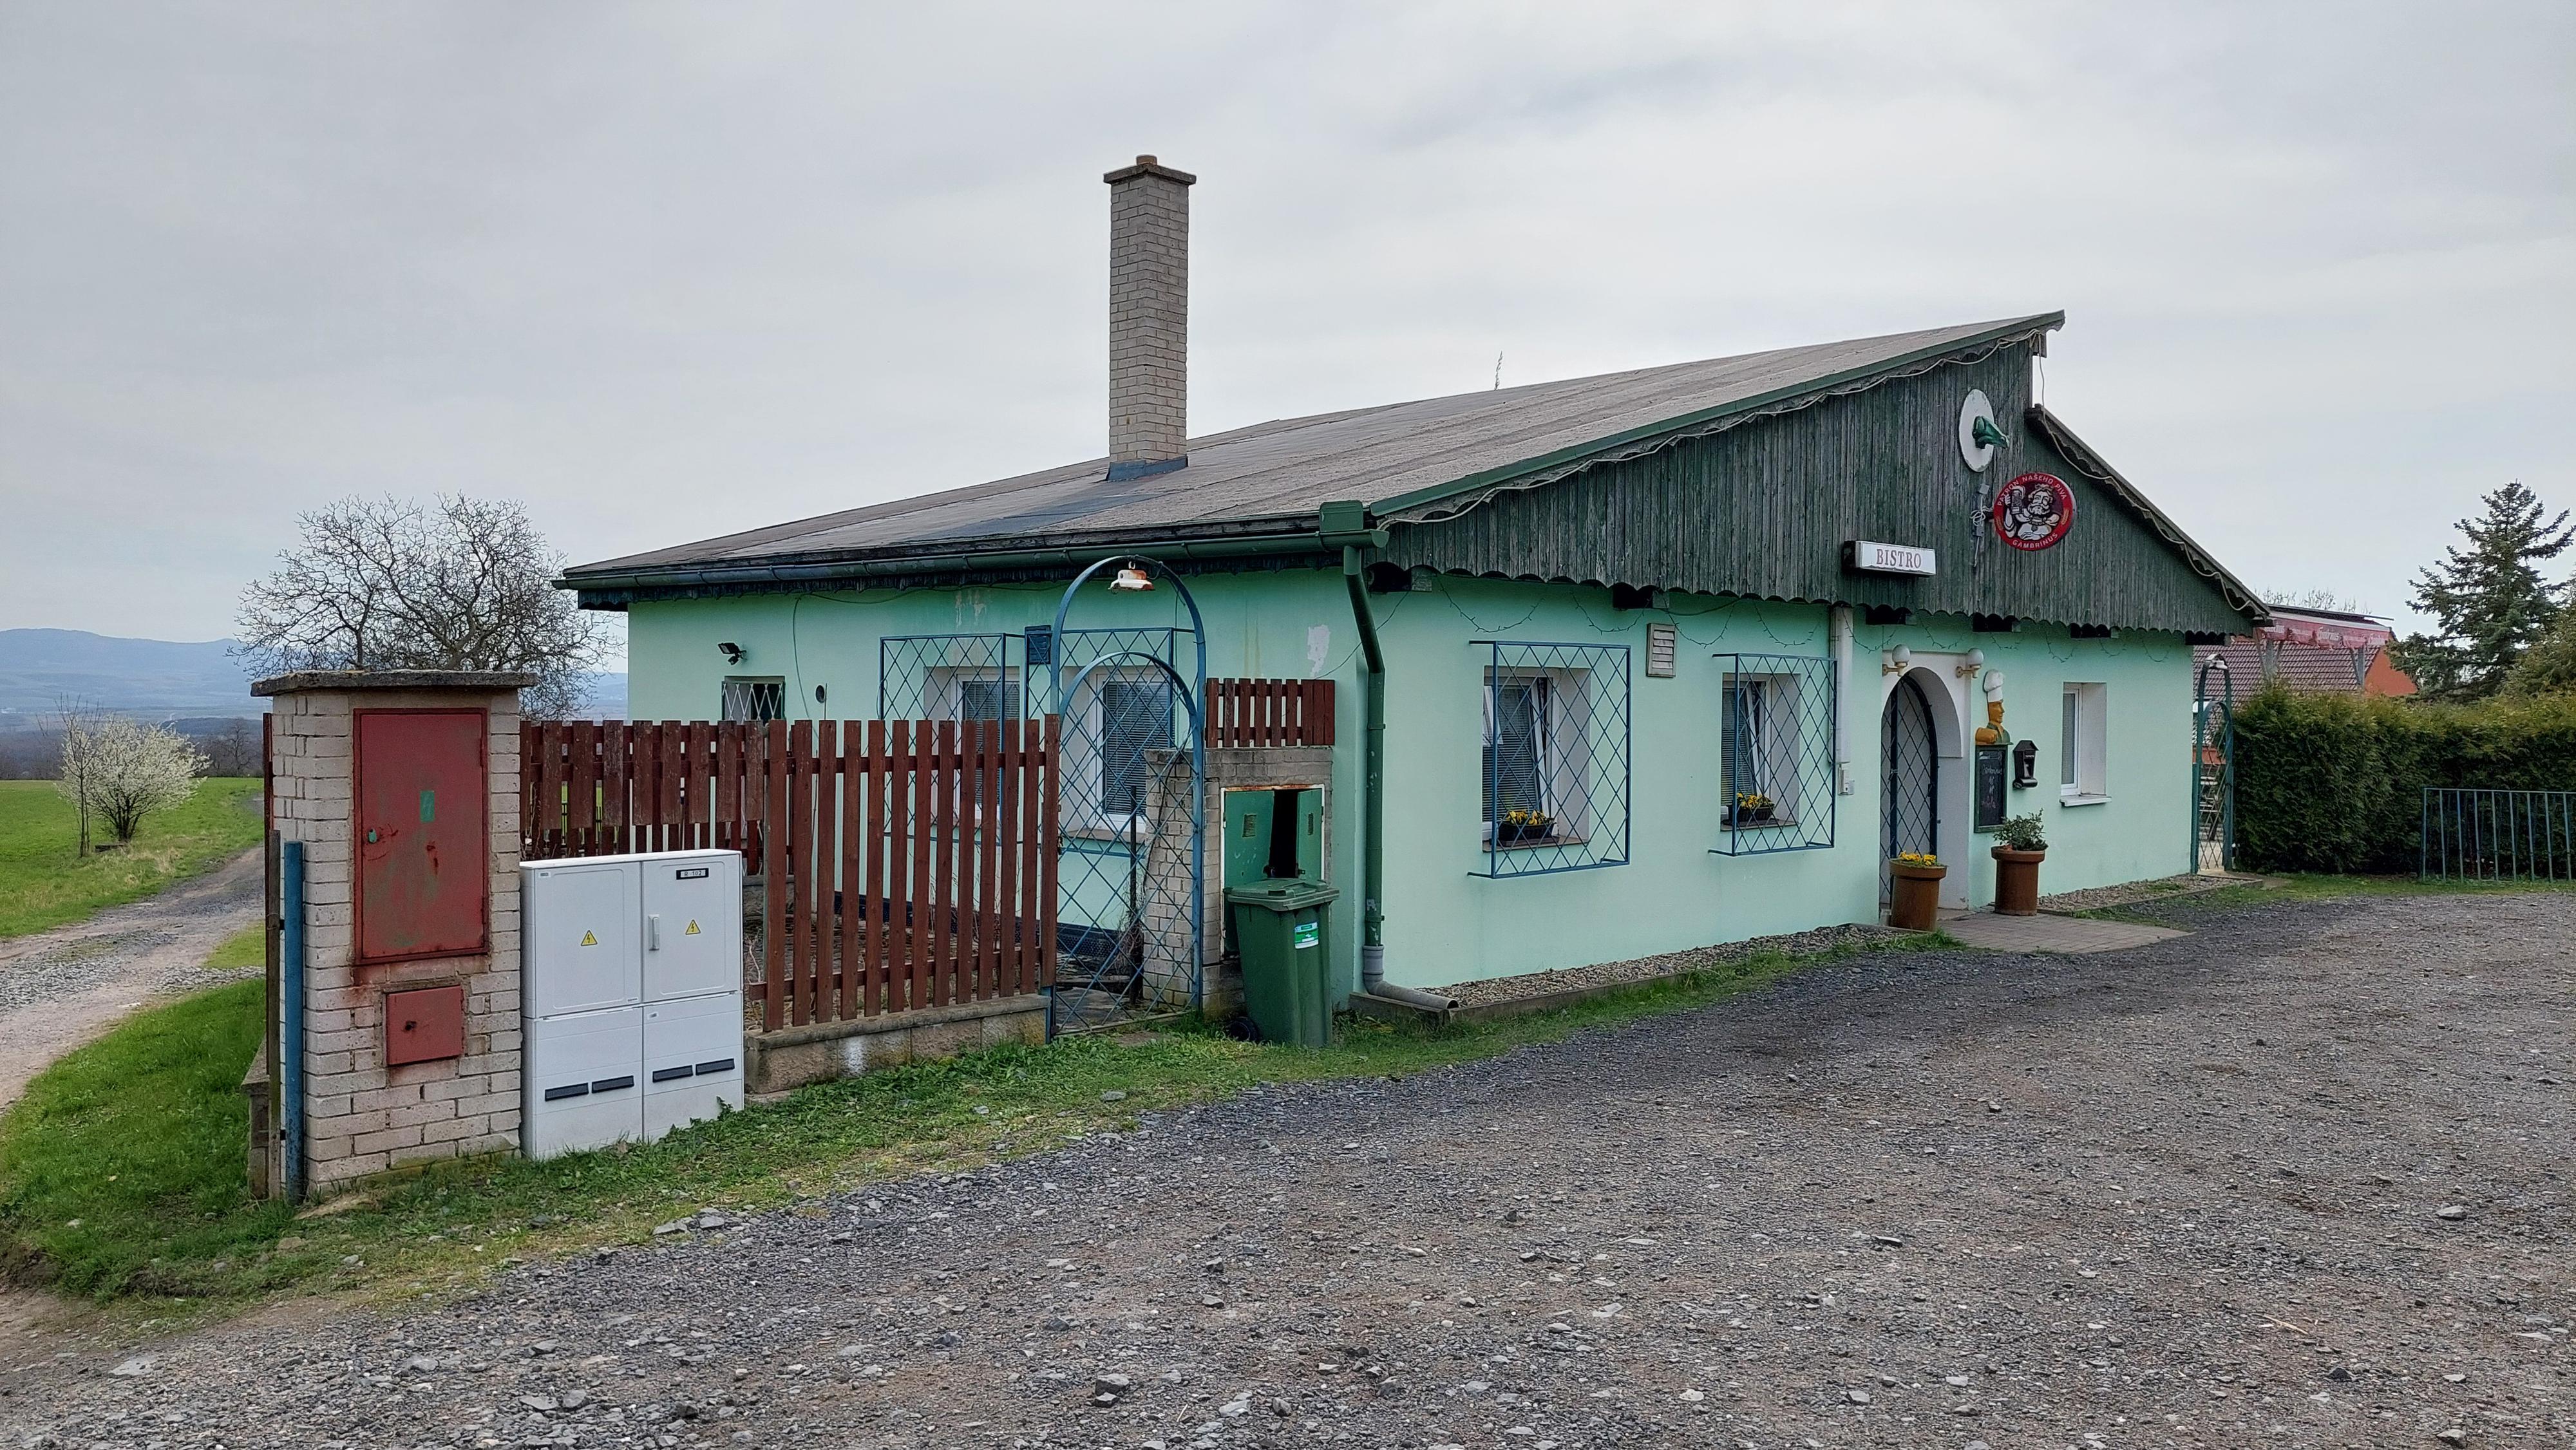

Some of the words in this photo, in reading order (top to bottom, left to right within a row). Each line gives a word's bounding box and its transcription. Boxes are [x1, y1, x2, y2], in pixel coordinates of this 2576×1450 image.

[1998, 480, 2019, 505] PATRON
[2022, 473, 2054, 484] NAŠEHO
[2055, 484, 2067, 500] PIVA
[2012, 532, 2058, 549] GAMBRINUS
[1877, 549, 1922, 569] BISTRO
